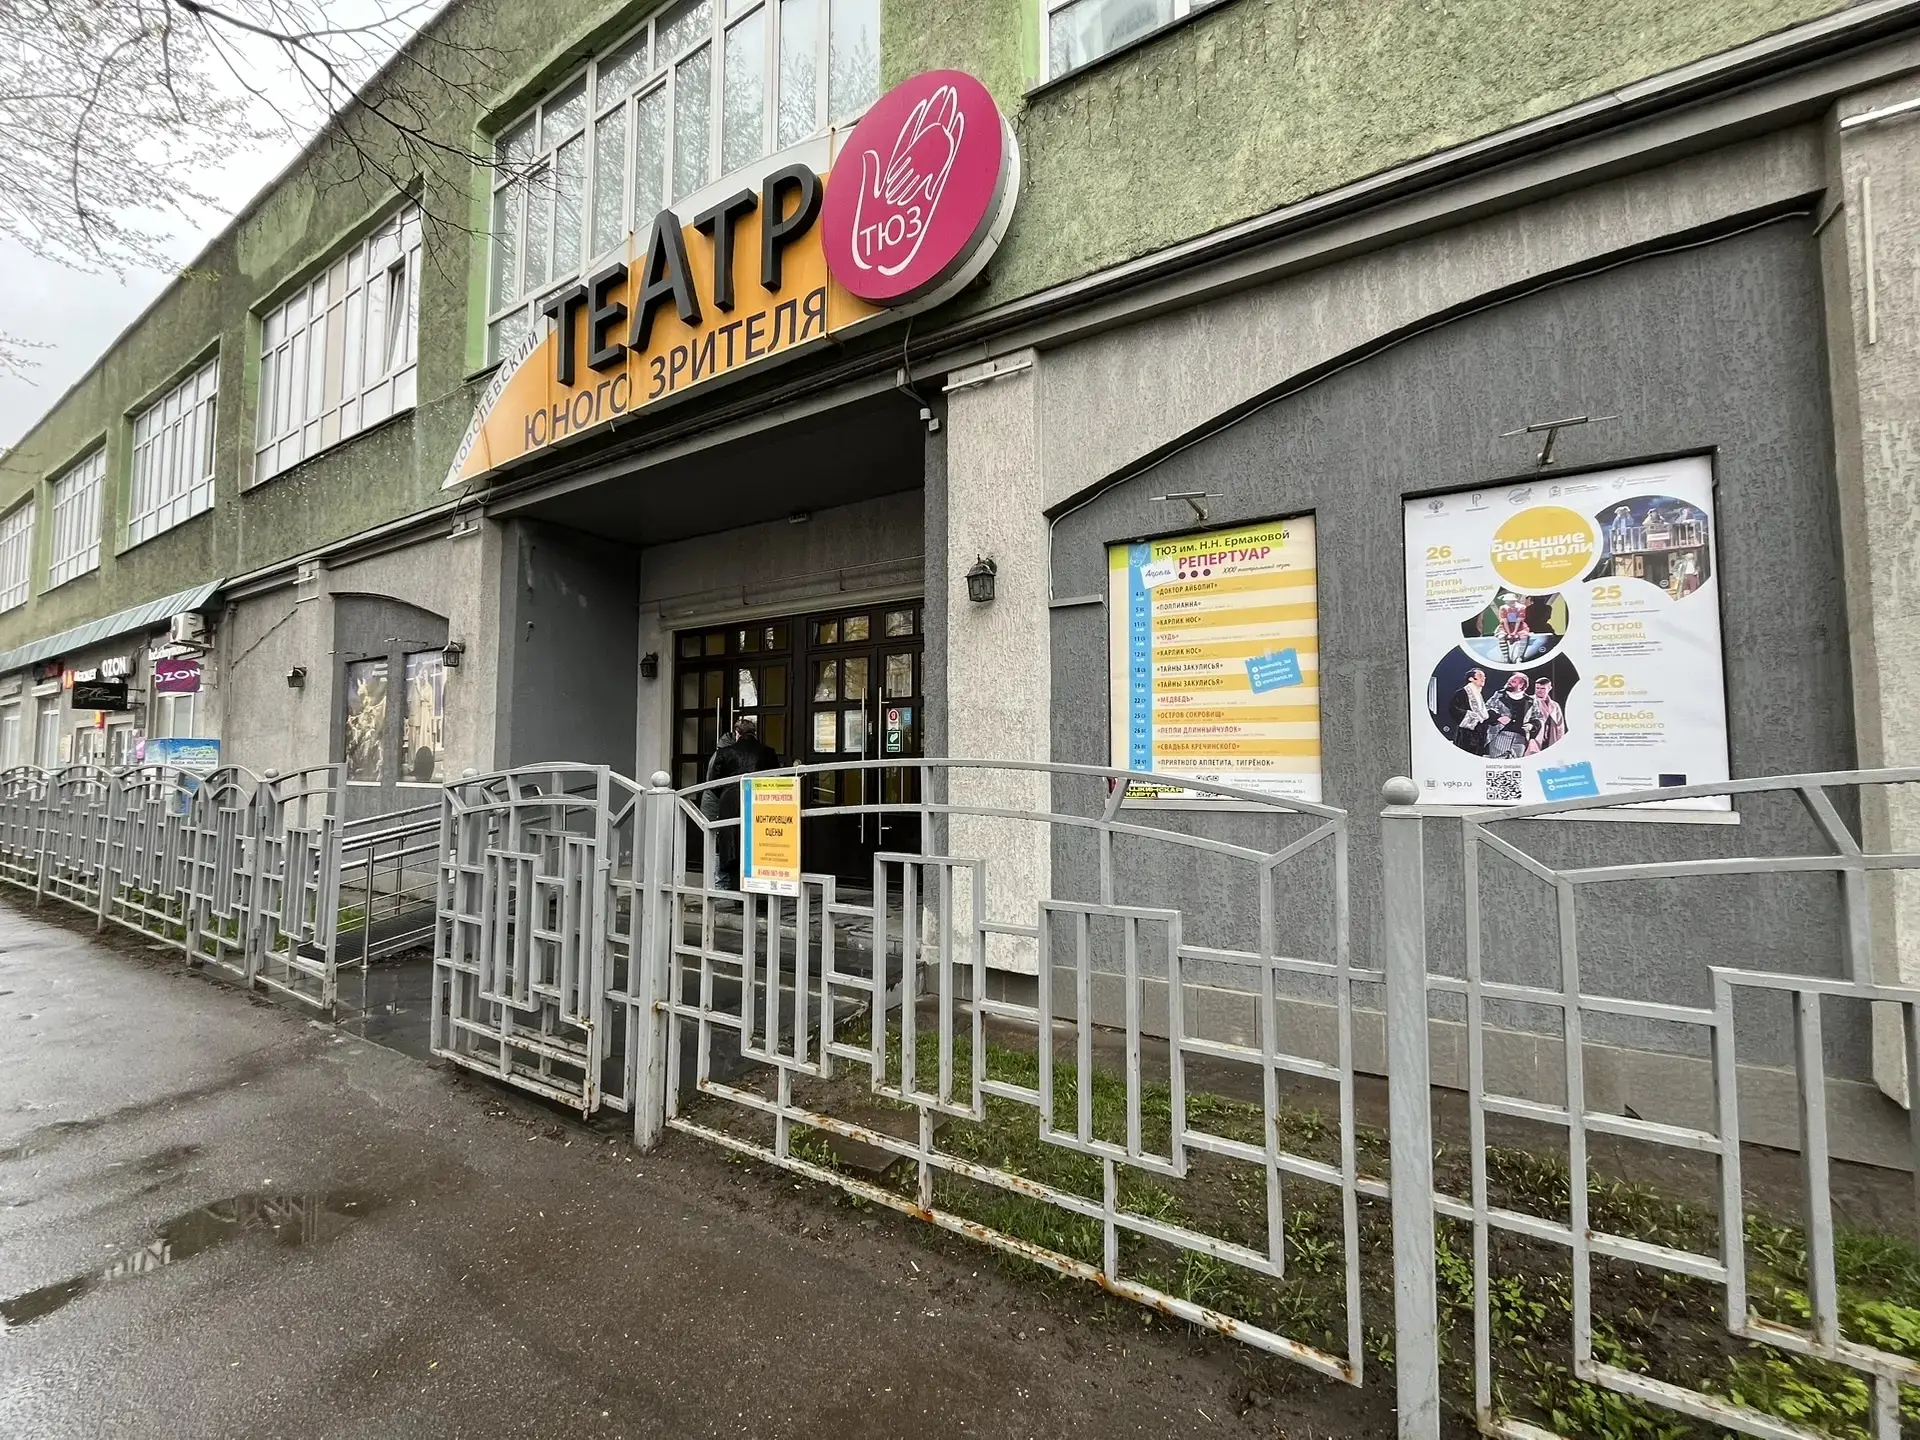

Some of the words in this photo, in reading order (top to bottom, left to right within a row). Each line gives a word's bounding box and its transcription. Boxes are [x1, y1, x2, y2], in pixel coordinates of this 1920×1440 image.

[859, 205, 922, 257] ТЮЗ
[543, 163, 824, 387] ТЕАТР
[525, 372, 632, 450] ЮНОГО
[648, 287, 826, 400] ЗРИТЕЛЯ
[452, 331, 538, 474] КОРОЛЁВСКИЙ
[1155, 545, 1177, 557] ТЮЗ
[1179, 545, 1197, 553] им.
[1200, 540, 1221, 550] Н.Н.
[1225, 529, 1290, 546] Ермаковой
[1491, 531, 1586, 553] Большие
[1178, 546, 1271, 569] РЕПЕРТУАР
[1426, 545, 1452, 560] 26
[1496, 541, 1593, 563] гастроли
[1426, 578, 1462, 588] Пеппи
[1156, 587, 1183, 596] «ДОКТОР
[1185, 582, 1218, 592] АЙБОЛИТ»
[1425, 584, 1495, 597] Длинныйчулок
[1591, 584, 1622, 600] 25
[1156, 600, 1201, 610] «ПОЛЛИАННА»
[1156, 617, 1185, 625] «КАРЛИК
[1591, 621, 1643, 632] Остров
[1591, 632, 1646, 642] сокровищ
[1156, 648, 1185, 656] «КАРЛИК
[102, 656, 126, 678] OZON
[1156, 664, 1182, 673] «ТАЙНЫ
[1183, 662, 1223, 671] ЗАКУЛИСЬЯ»
[155, 667, 201, 683] OZON
[1157, 680, 1182, 688] «ТАЙНЫ
[1183, 678, 1224, 687] ЗАКУЛИСЬЯ»
[1593, 674, 1625, 689] 26
[1157, 695, 1193, 704] «МЕДВЕДЬ»
[1157, 711, 1184, 719] «ОСТРОВ
[1185, 710, 1225, 719] СОКРОВИЩ»
[1594, 709, 1654, 721] Свадьба
[1183, 726, 1241, 734] ДЛИННЫЙЧУЛОК»
[1594, 722, 1665, 731] Кречинского
[1191, 742, 1240, 750] КРЕЧИНСКОГО»
[1199, 759, 1235, 767] АППЕТИТА,
[1236, 758, 1274, 766] ТИГРЁНОК»
[1443, 780, 1472, 788] vgkp.ru
[755, 815, 793, 825] МОНТИРОВЩИК
[765, 827, 783, 837] СЦЕНЫ
